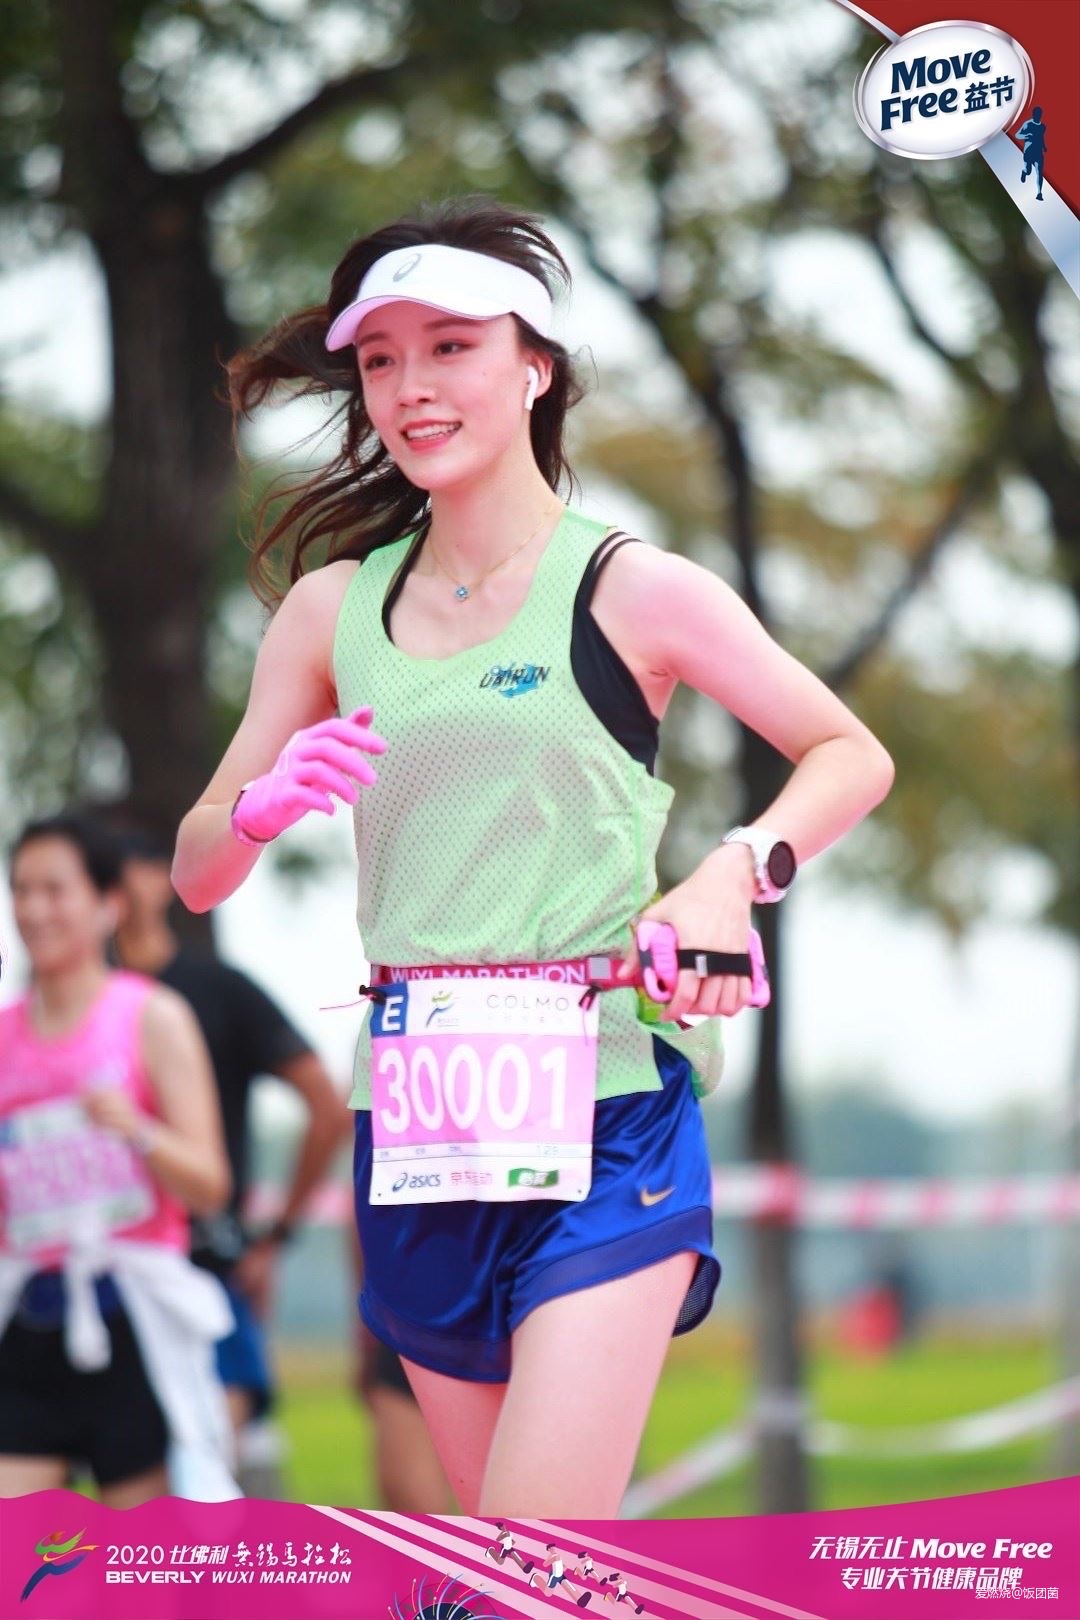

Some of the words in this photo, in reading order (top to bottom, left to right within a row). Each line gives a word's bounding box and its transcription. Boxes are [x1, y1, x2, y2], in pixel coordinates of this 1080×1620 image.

[381, 996, 404, 1032] E
[486, 994, 570, 1011] COLMO
[377, 1044, 568, 1134] 30001
